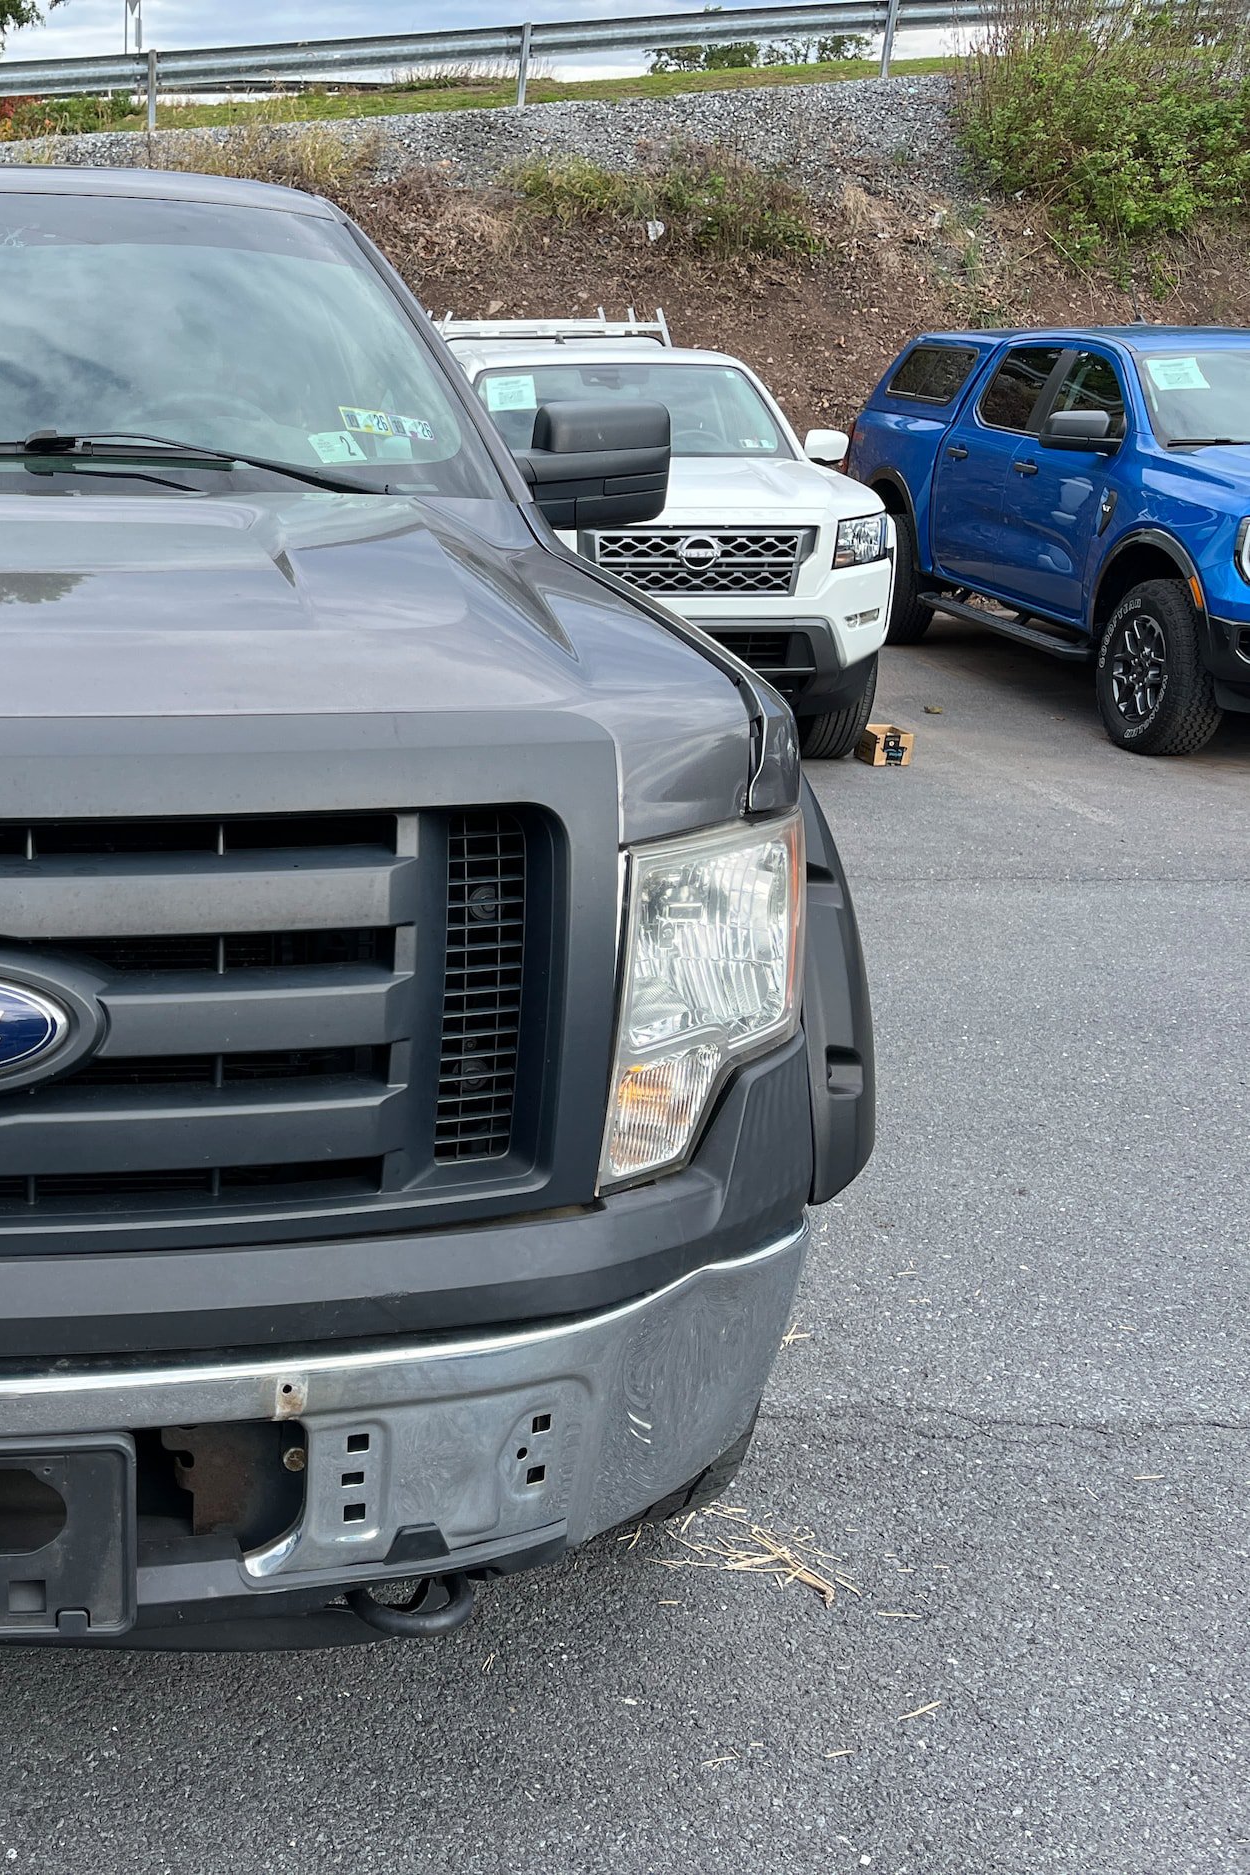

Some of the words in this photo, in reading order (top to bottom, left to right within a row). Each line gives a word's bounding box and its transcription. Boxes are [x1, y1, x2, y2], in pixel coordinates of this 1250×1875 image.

[373, 414, 389, 432] 26
[417, 421, 433, 439] 26
[678, 550, 721, 558] NISSAN
[1098, 598, 1142, 669] GOODYEAR
